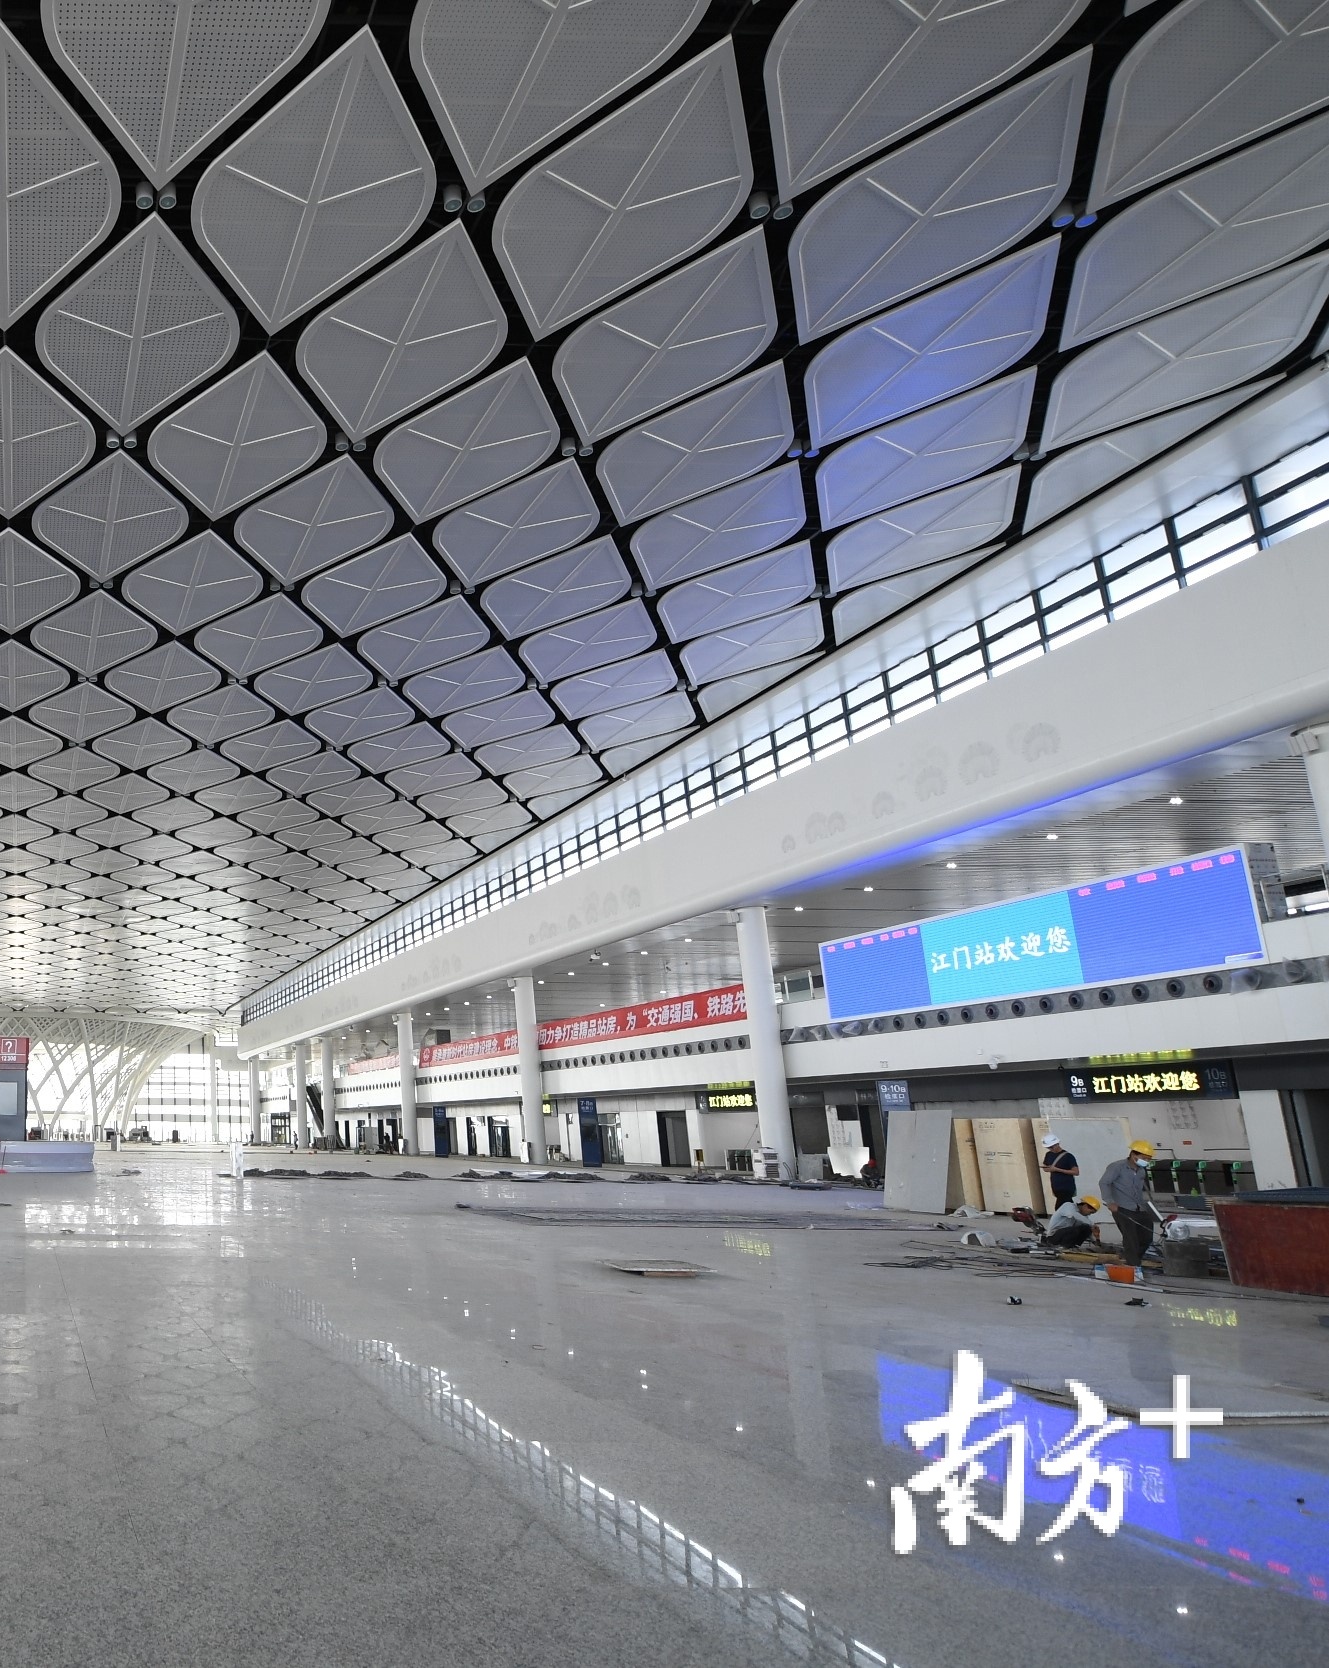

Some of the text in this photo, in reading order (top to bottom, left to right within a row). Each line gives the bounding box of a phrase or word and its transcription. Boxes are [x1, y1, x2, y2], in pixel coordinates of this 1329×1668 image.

[930, 925, 1071, 974] 江门站欢迎您
[1070, 1075, 1085, 1087] 9B
[1092, 1070, 1200, 1094] 江门站欢迎您
